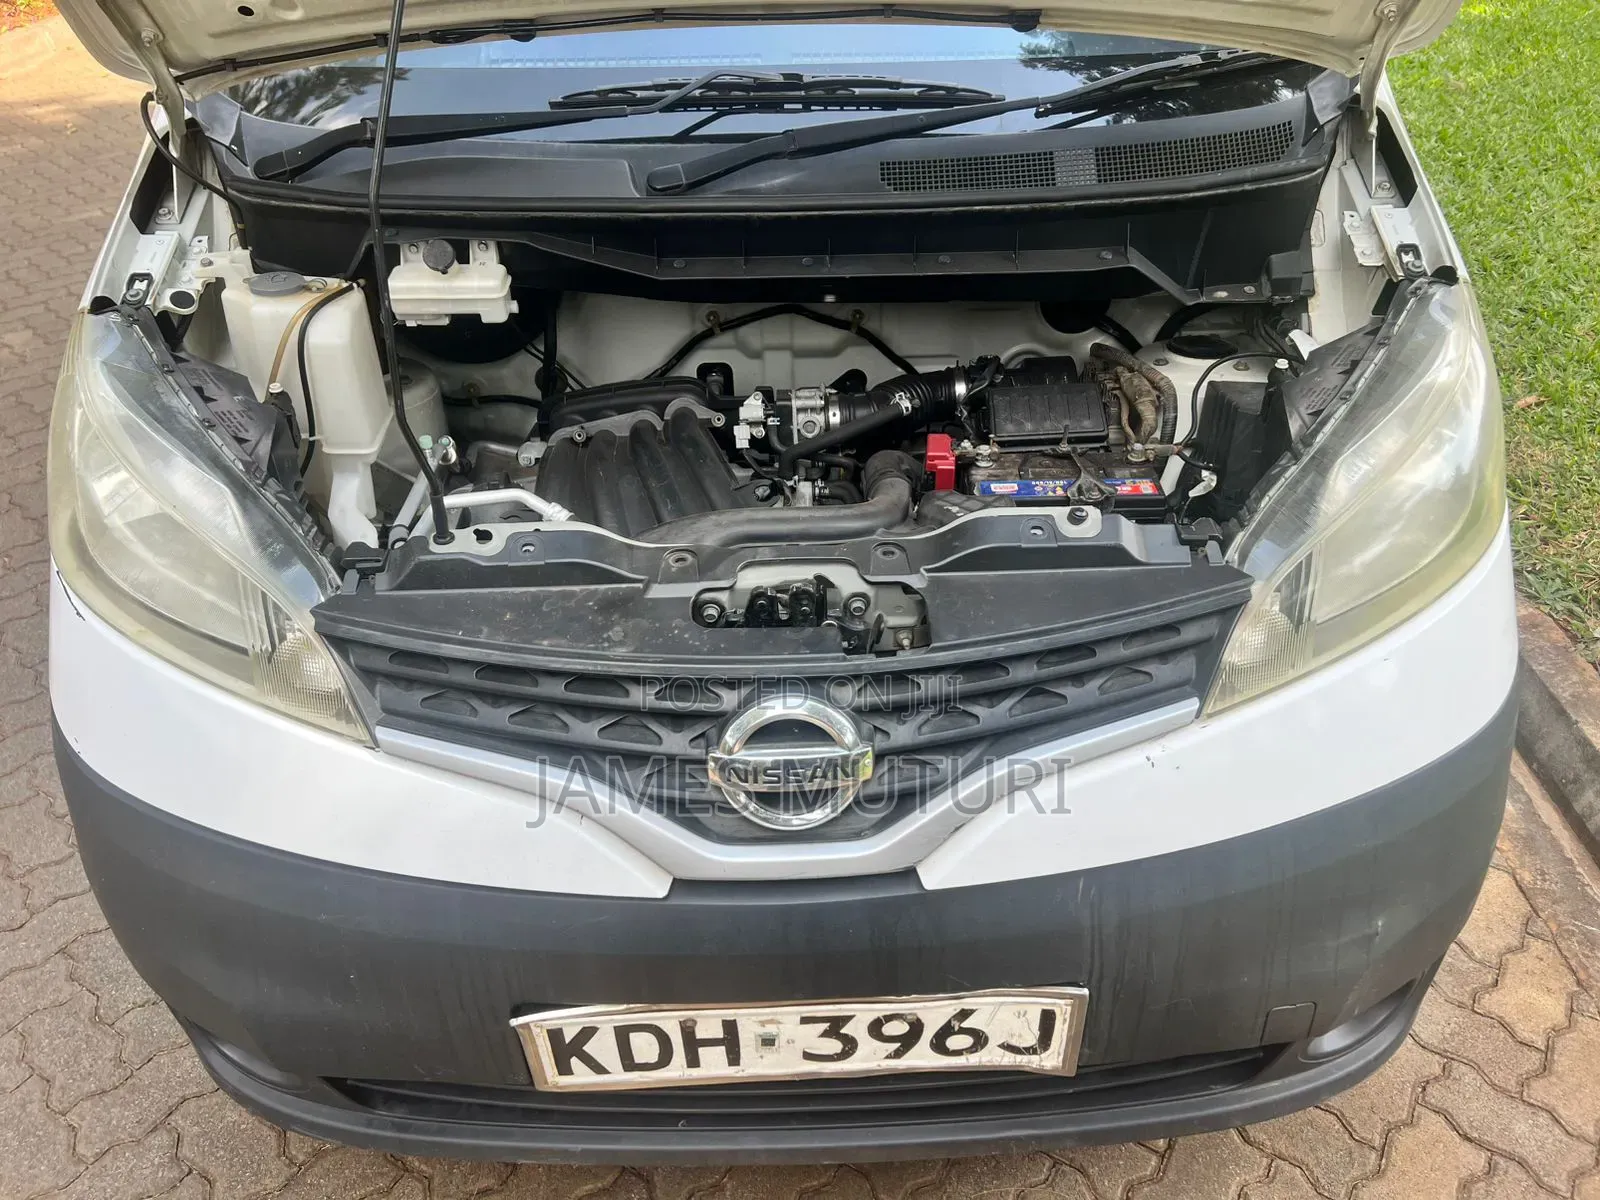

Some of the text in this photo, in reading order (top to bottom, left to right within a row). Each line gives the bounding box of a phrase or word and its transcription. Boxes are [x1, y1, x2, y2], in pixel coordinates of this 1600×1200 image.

[727, 758, 860, 784] NISSAN
[546, 1007, 1056, 1076] KDH 396J
